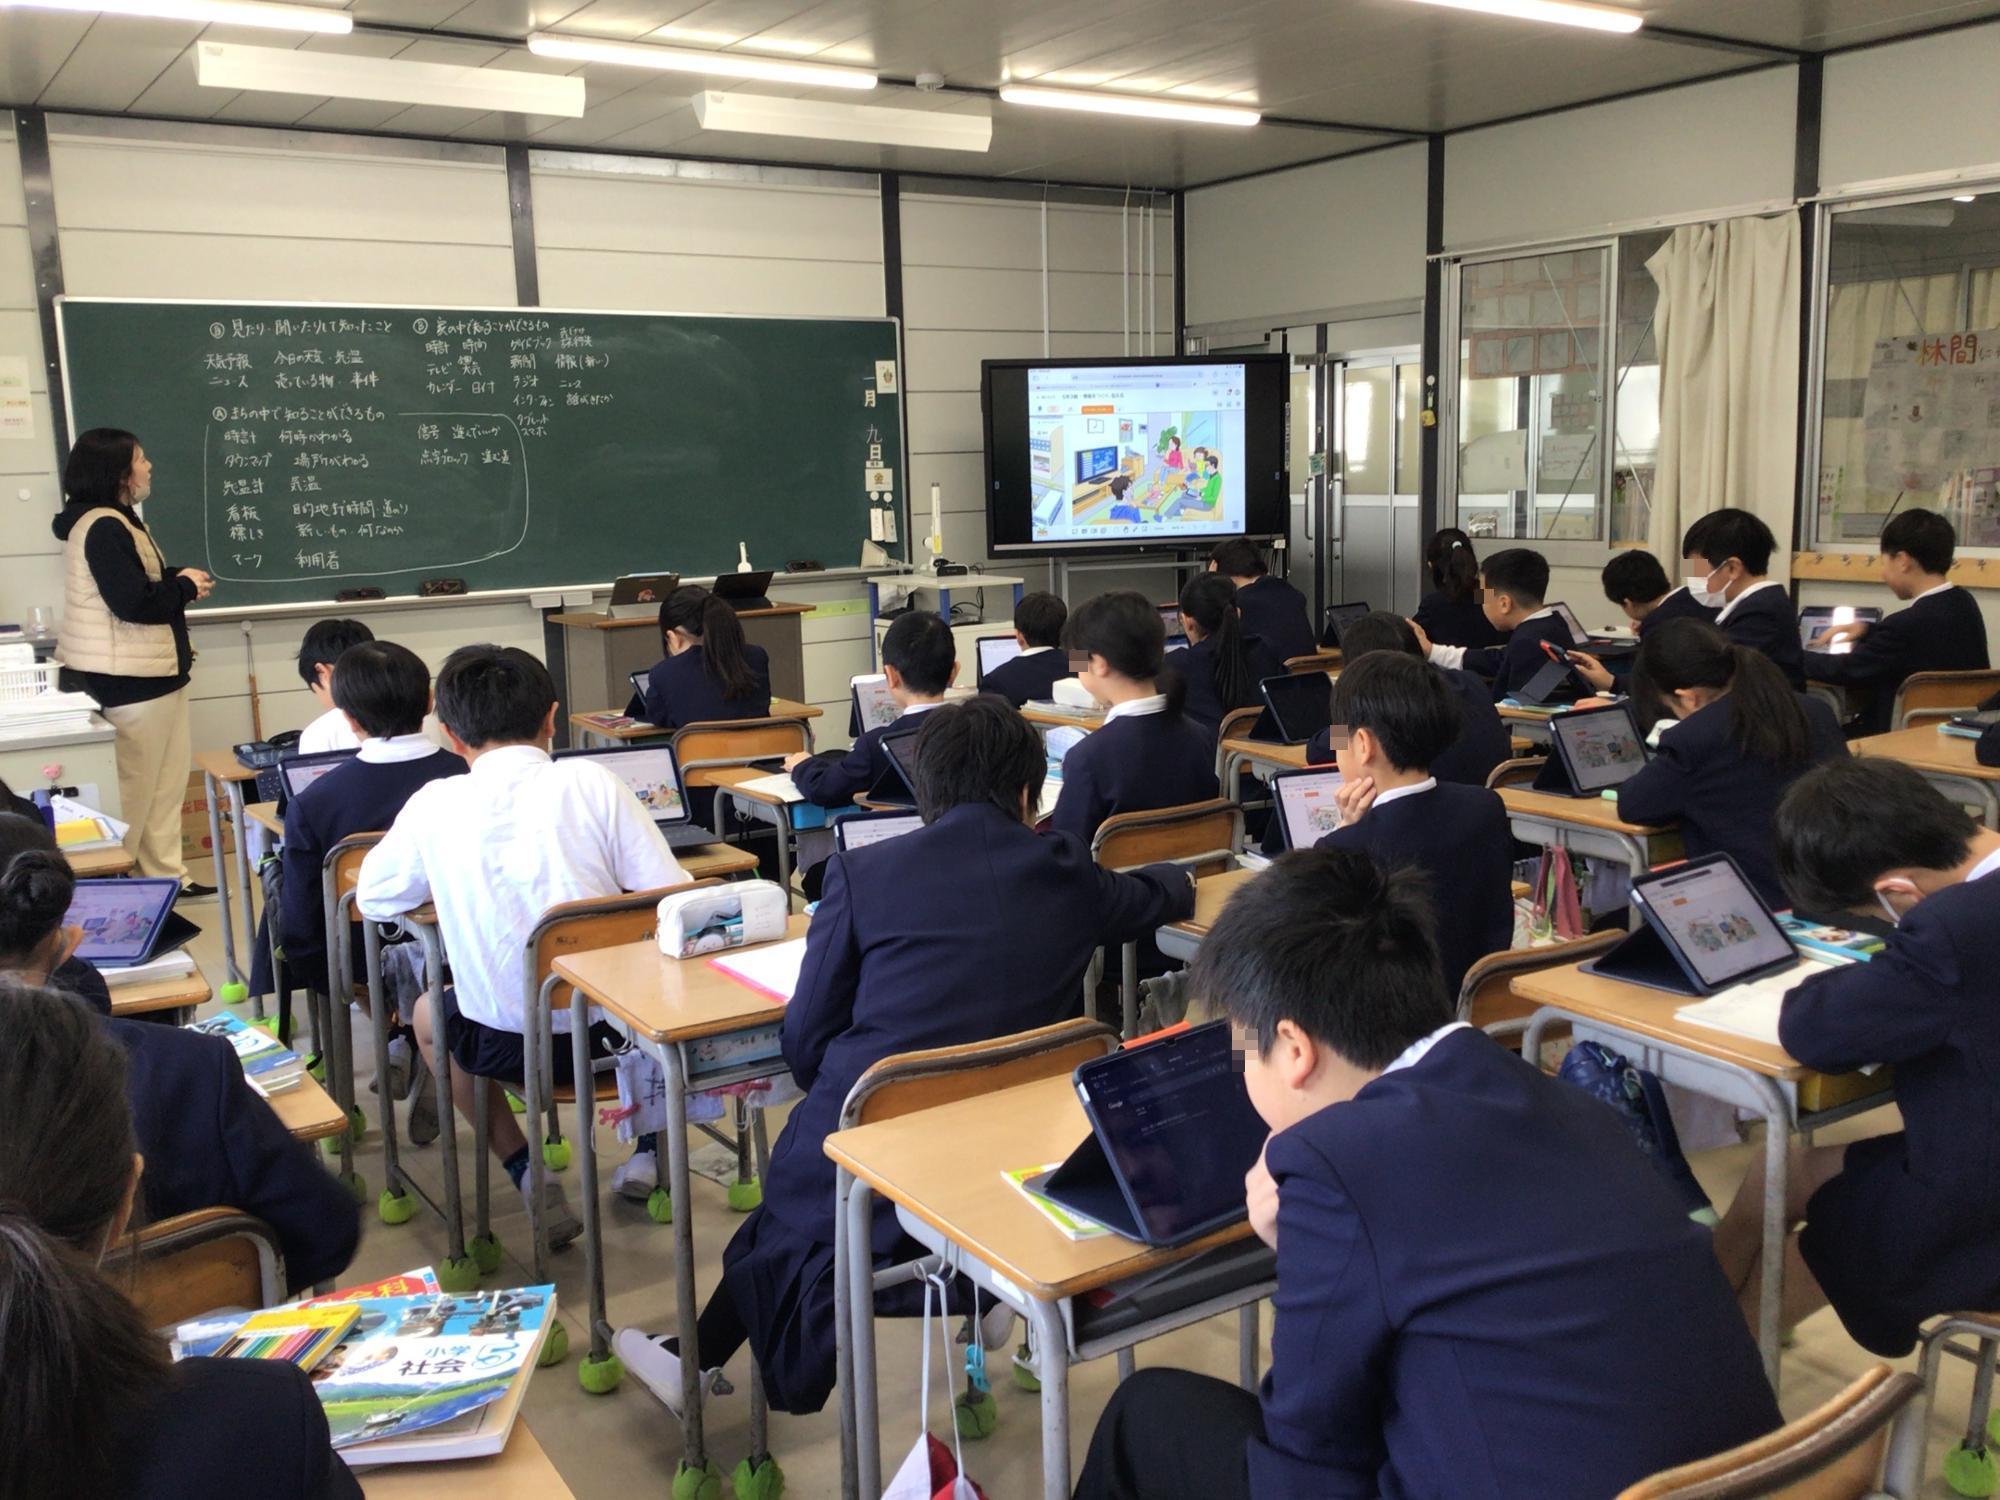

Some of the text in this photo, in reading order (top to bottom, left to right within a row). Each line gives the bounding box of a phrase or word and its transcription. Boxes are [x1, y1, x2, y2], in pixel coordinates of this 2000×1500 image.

[204, 352, 252, 370] 天気予報
[227, 503, 261, 522] 看板
[232, 554, 262, 568] マーク
[425, 1345, 471, 1358] 小学
[398, 1357, 466, 1377] 社会
